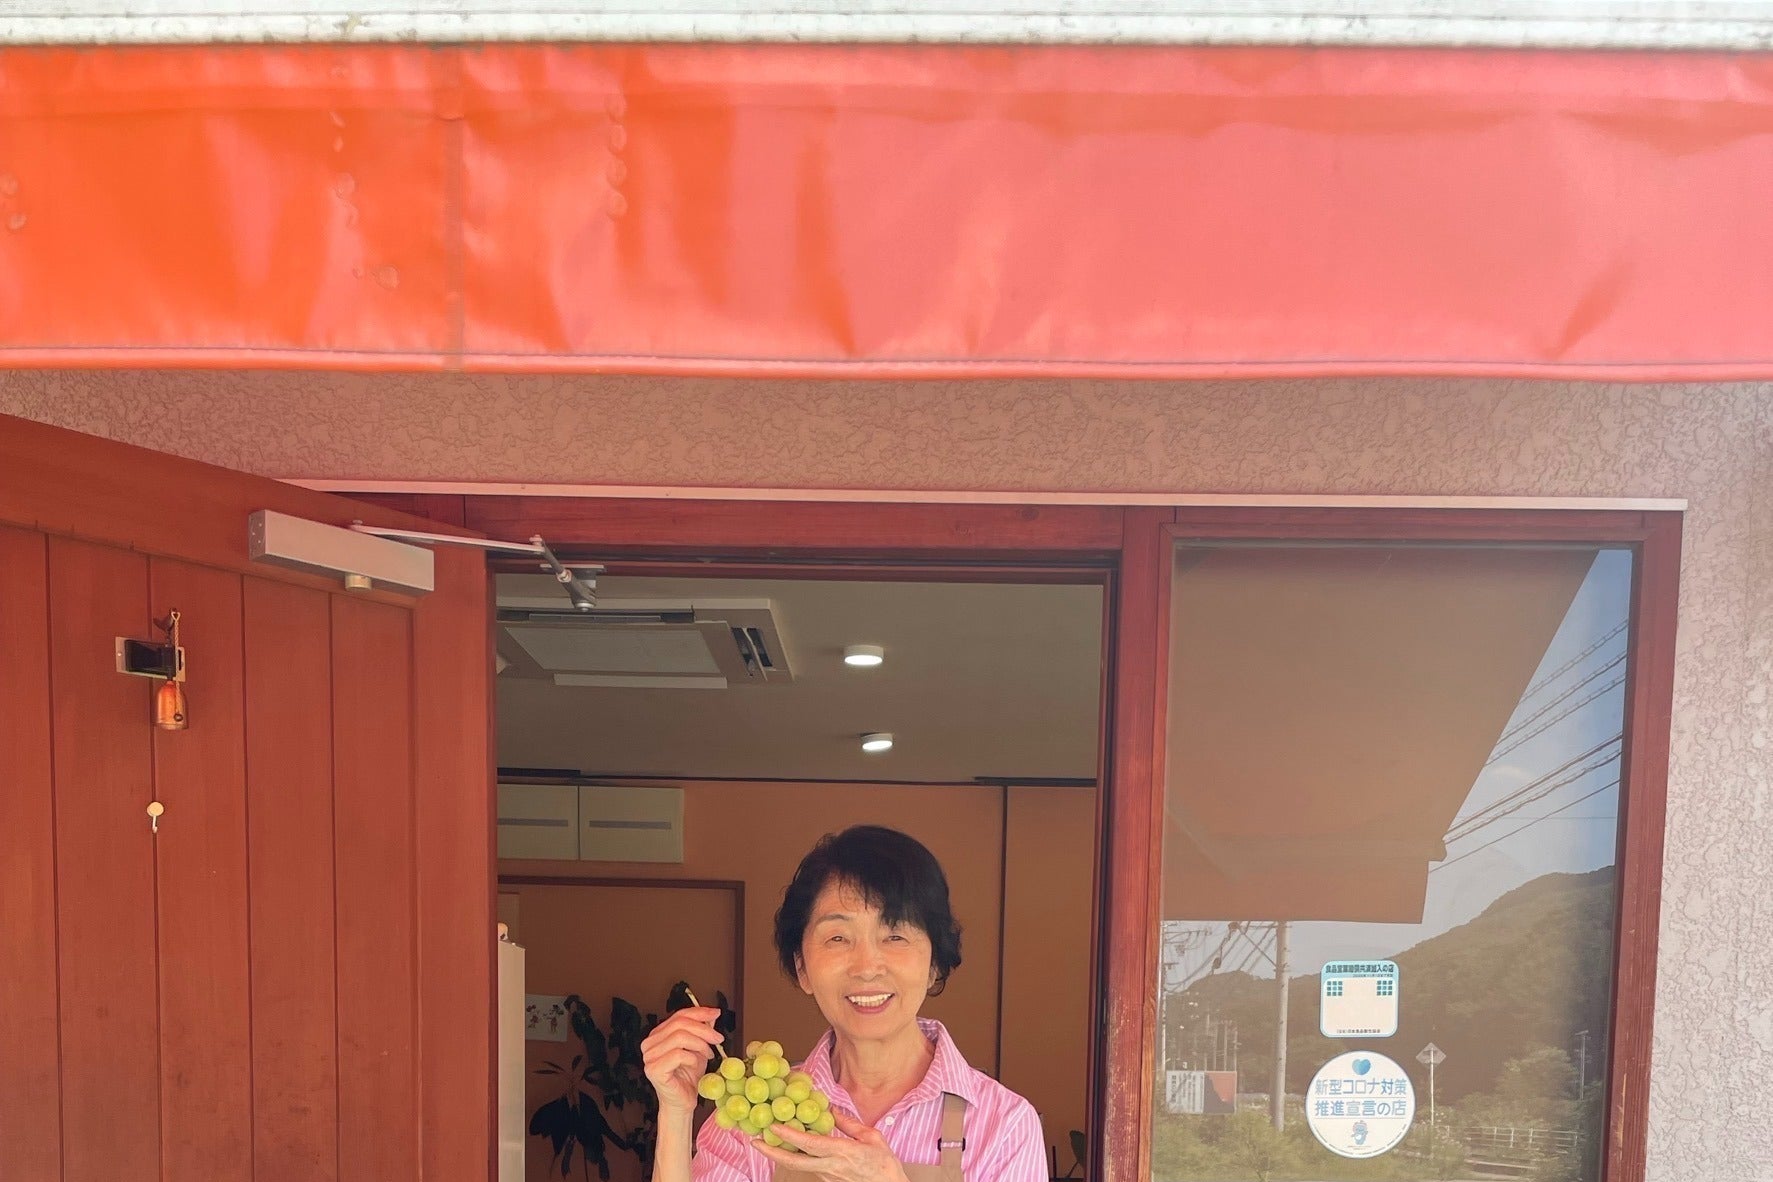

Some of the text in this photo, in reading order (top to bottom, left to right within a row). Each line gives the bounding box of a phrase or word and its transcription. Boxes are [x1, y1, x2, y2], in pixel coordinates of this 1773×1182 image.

[1315, 1078, 1407, 1095] 新型コロナ対策
[1315, 1099, 1407, 1116] 推進宣言の店
